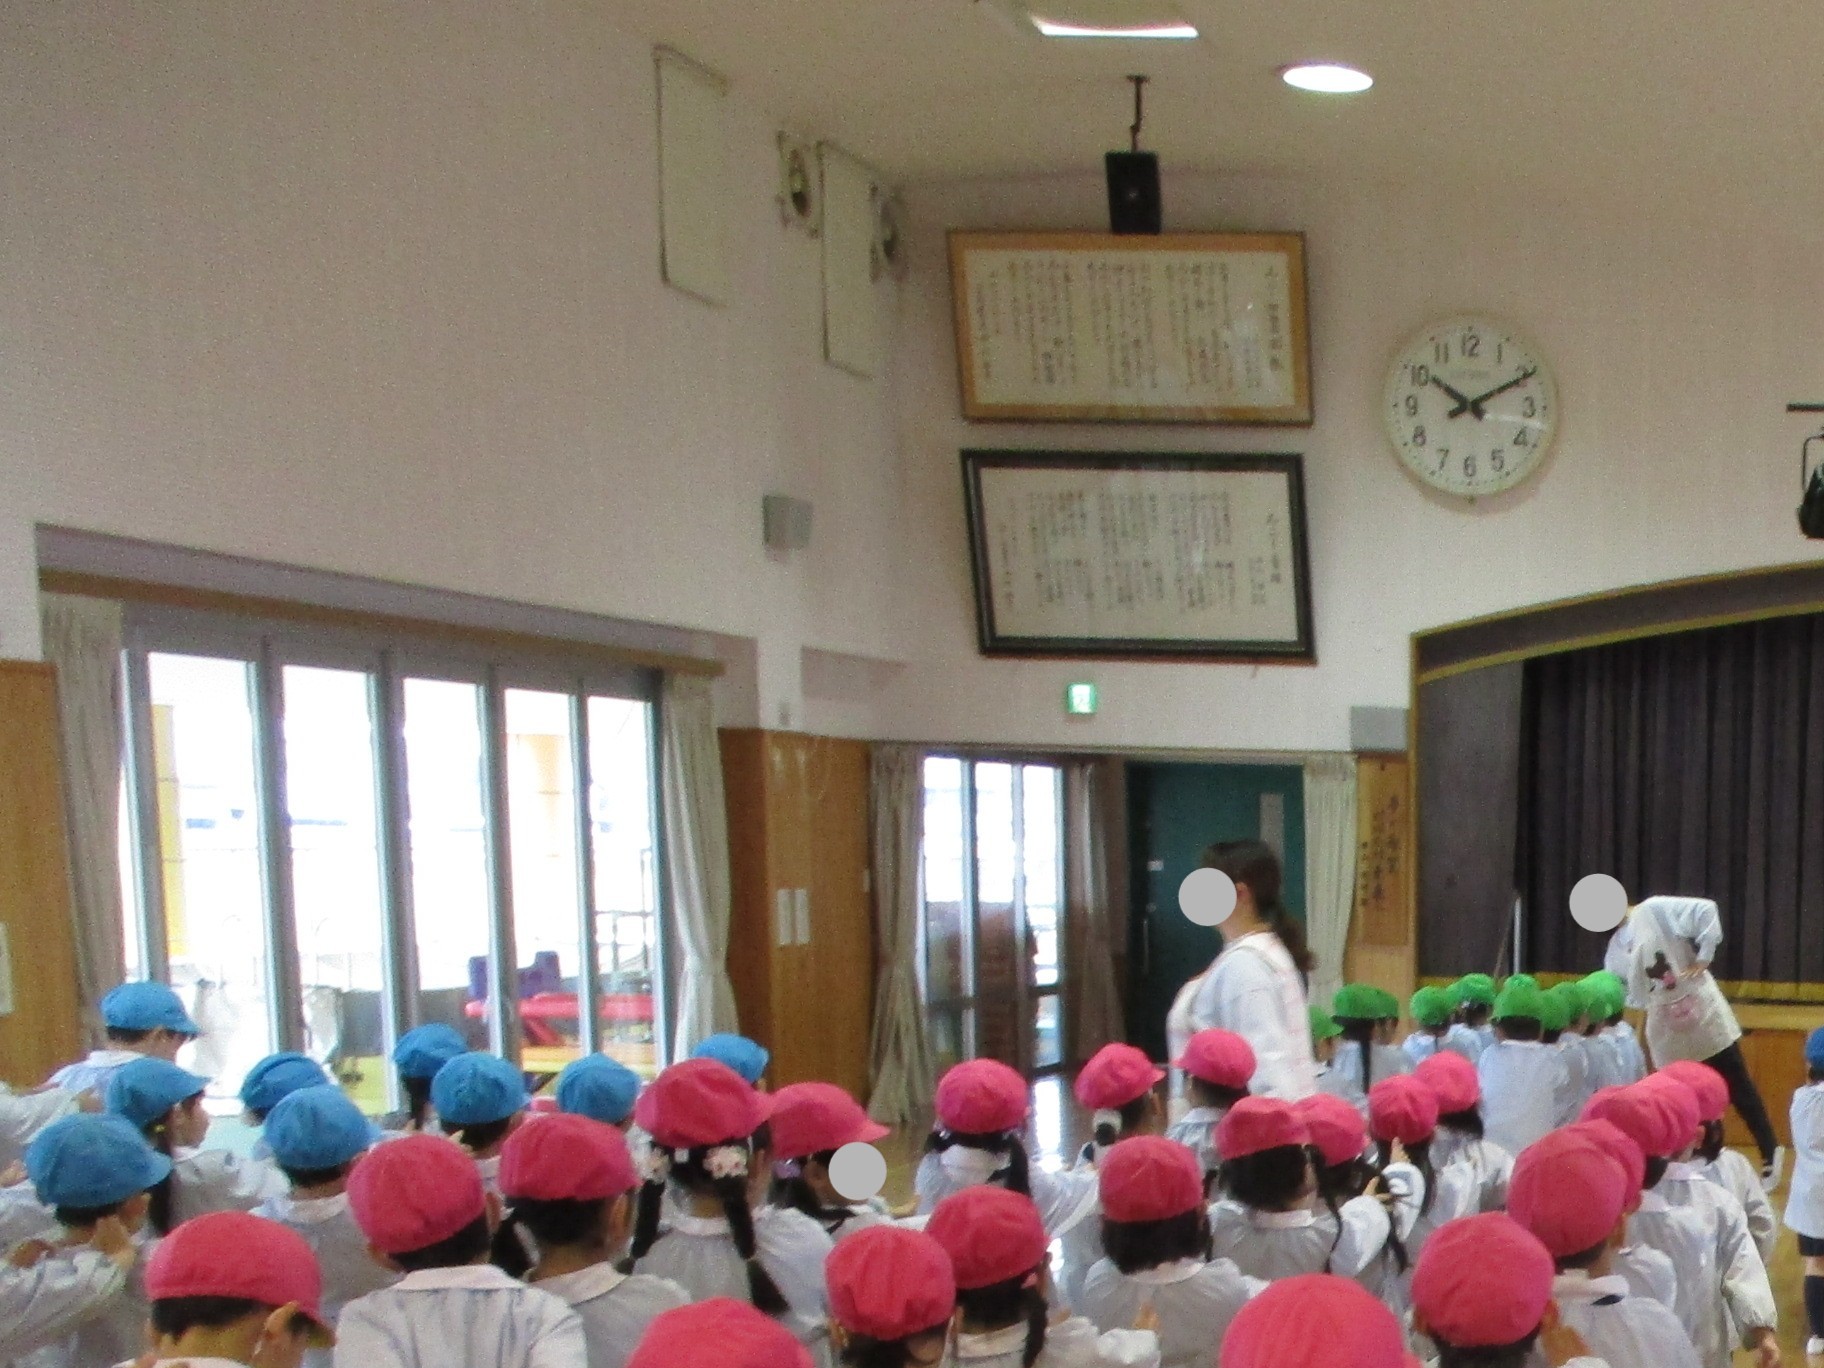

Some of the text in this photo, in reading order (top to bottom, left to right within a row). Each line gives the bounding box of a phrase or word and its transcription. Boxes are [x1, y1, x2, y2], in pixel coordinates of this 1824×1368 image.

[1434, 342, 1449, 364] 11
[1461, 334, 1480, 357] 12
[1411, 364, 1429, 387] 10
[1405, 395, 1418, 417] 9
[1523, 396, 1536, 418] 3
[1412, 425, 1427, 447] 8
[1513, 426, 1528, 447] 4
[1435, 448, 1450, 470] 7
[1463, 454, 1477, 478] 6
[1490, 449, 1505, 472] 5
